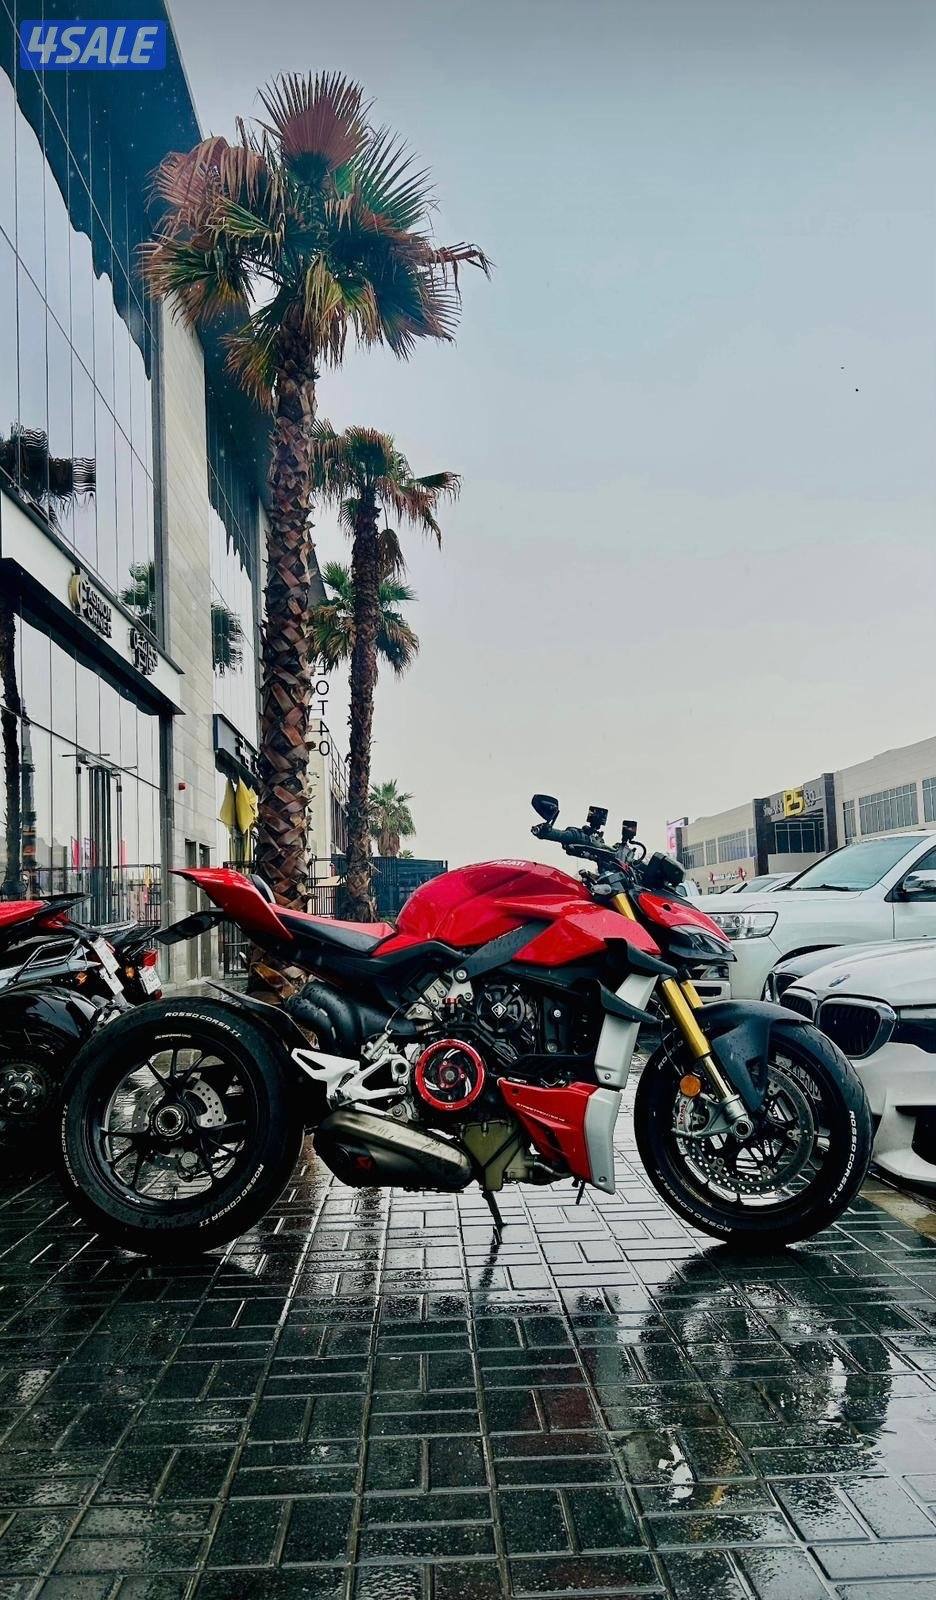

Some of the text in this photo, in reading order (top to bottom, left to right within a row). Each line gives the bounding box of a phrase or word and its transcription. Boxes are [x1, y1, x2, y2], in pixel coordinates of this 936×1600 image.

[199, 1015, 231, 1031] CORSA
[657, 1040, 684, 1070] ROSO
[849, 1110, 857, 1153] ROSSO
[63, 1154, 79, 1187] ROSSO
[241, 1163, 264, 1197] ROSSO
[837, 1153, 855, 1191] CORSA
[211, 1195, 242, 1221] CORSA
[694, 1212, 732, 1232] ROSSO
